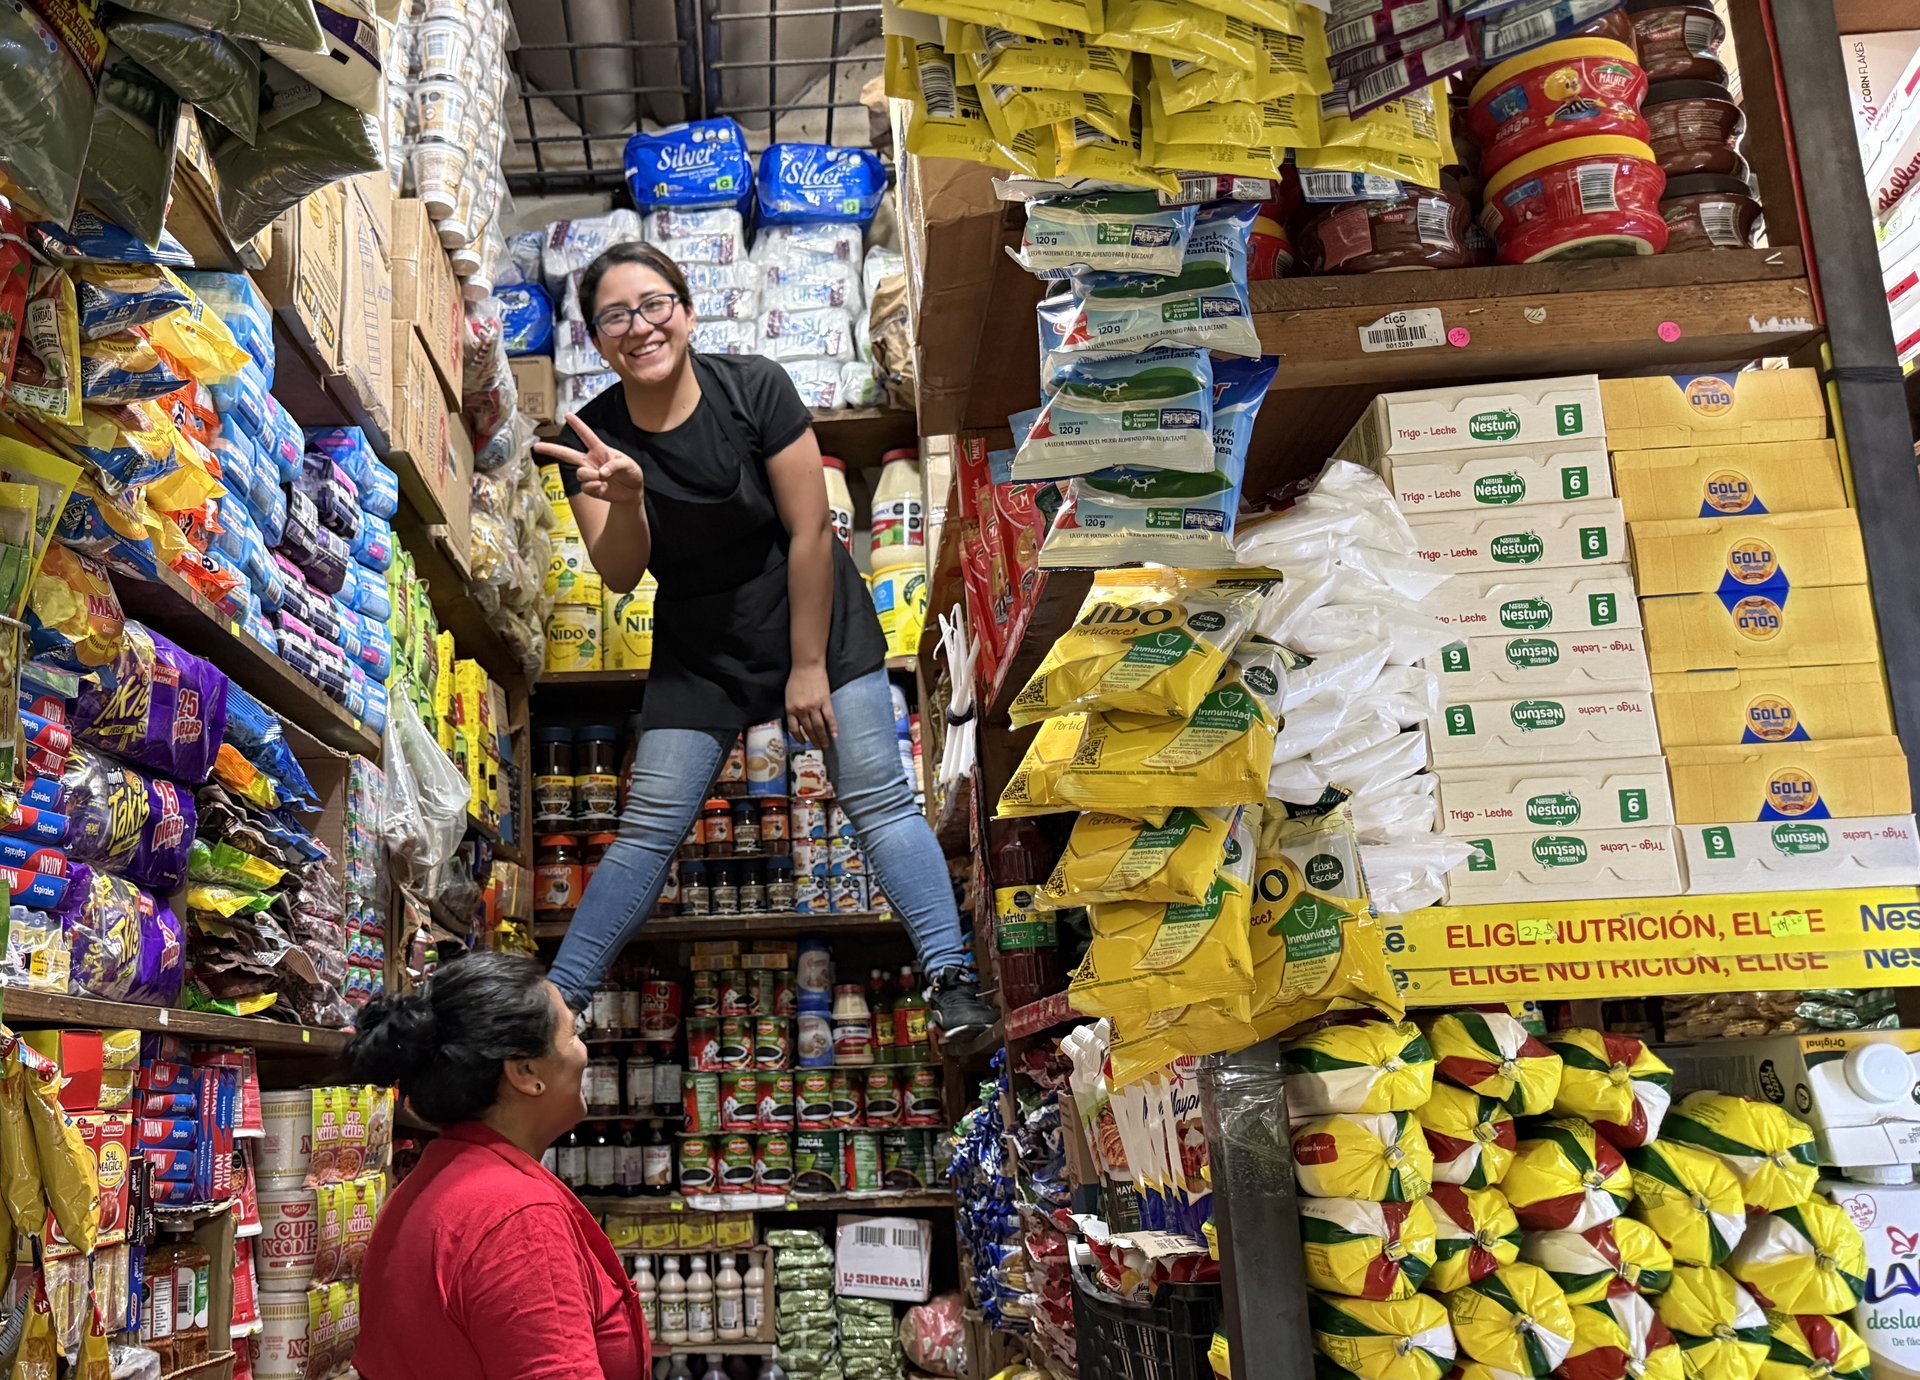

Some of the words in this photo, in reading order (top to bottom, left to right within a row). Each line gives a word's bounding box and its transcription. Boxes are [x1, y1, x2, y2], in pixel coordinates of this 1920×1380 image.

[1854, 42, 1868, 75] FLAKES
[1861, 76, 1872, 103] CORN
[657, 143, 713, 171] Silver
[785, 161, 845, 186] Silver
[653, 182, 668, 199] 10
[1036, 236, 1050, 245] 120
[1099, 325, 1112, 335] 120
[1691, 392, 1731, 406] GOLD
[1059, 426, 1072, 434] 120
[1398, 429, 1420, 441] Trigo
[1430, 425, 1456, 436] Leche
[1471, 420, 1516, 433] Nestum
[1475, 484, 1521, 496] Nestum
[1708, 482, 1747, 494] GOLD
[1401, 491, 1424, 503] Trigo
[1435, 489, 1461, 500] Leche
[1085, 518, 1098, 527] 120
[1417, 551, 1440, 562] Trigo
[1450, 547, 1477, 558] Leche
[1493, 541, 1540, 555] Nestum
[1731, 551, 1771, 564] GOLD
[89, 594, 124, 622] MAX
[1501, 607, 1549, 621] Nestum
[1198, 614, 1219, 623] Edad
[1459, 613, 1487, 624] Leche
[1739, 615, 1779, 628] GOLD
[550, 629, 584, 642] NIDO
[1133, 644, 1182, 657] Inmunidad
[1509, 646, 1557, 659] Nestum
[1572, 643, 1599, 653] Leche
[1610, 641, 1635, 652] Trigo
[179, 688, 199, 719] 25
[1578, 704, 1606, 715] Leche
[1617, 701, 1642, 713] Trigo
[44, 701, 62, 723] AUTAN
[1198, 708, 1251, 720] Inmunidad
[1514, 707, 1564, 720] Nestum
[1750, 708, 1791, 721] GOLD
[173, 719, 202, 745] piezas
[50, 729, 69, 750] AUTAN
[45, 751, 62, 770] AUTAN
[1770, 781, 1812, 794] GOLD
[31, 790, 51, 803] Espirales
[153, 779, 179, 817] 25
[1450, 809, 1474, 822] Trigo
[1485, 807, 1513, 819] Leche
[1528, 803, 1577, 816] Nestum
[108, 787, 150, 850] Takis
[37, 822, 58, 835] Espirales
[152, 816, 184, 851] piezas
[1842, 830, 1873, 840] Leche
[1882, 827, 1908, 839] Trigo
[1639, 838, 1665, 851] Trigo
[1774, 832, 1827, 844] Nestum
[1535, 845, 1585, 857] Nestum
[1600, 841, 1629, 851] Leche
[39, 855, 62, 876] AUTAN
[1312, 861, 1334, 872] Edad
[1310, 870, 1342, 884] Escolar
[33, 884, 55, 897] Espirales
[1860, 904, 1920, 932] Nes
[1286, 925, 1337, 945] Inmunidad
[1446, 923, 1536, 949] ELIG
[1732, 908, 1826, 936] ELE
[1865, 948, 1920, 969] Nes
[1450, 965, 1540, 987] ELIGE
[1736, 952, 1829, 973] ELIGE
[1806, 1037, 1845, 1049] Original
[143, 1122, 162, 1137] AUTAN
[105, 1151, 118, 1161] SAL
[214, 1154, 224, 1190] AUTAN
[223, 1153, 232, 1189] AUTAN
[284, 1204, 309, 1214] NISSIN
[275, 1221, 317, 1240] CUP
[262, 1238, 318, 1258] NOODLE
[855, 1273, 909, 1288] SIRENA
